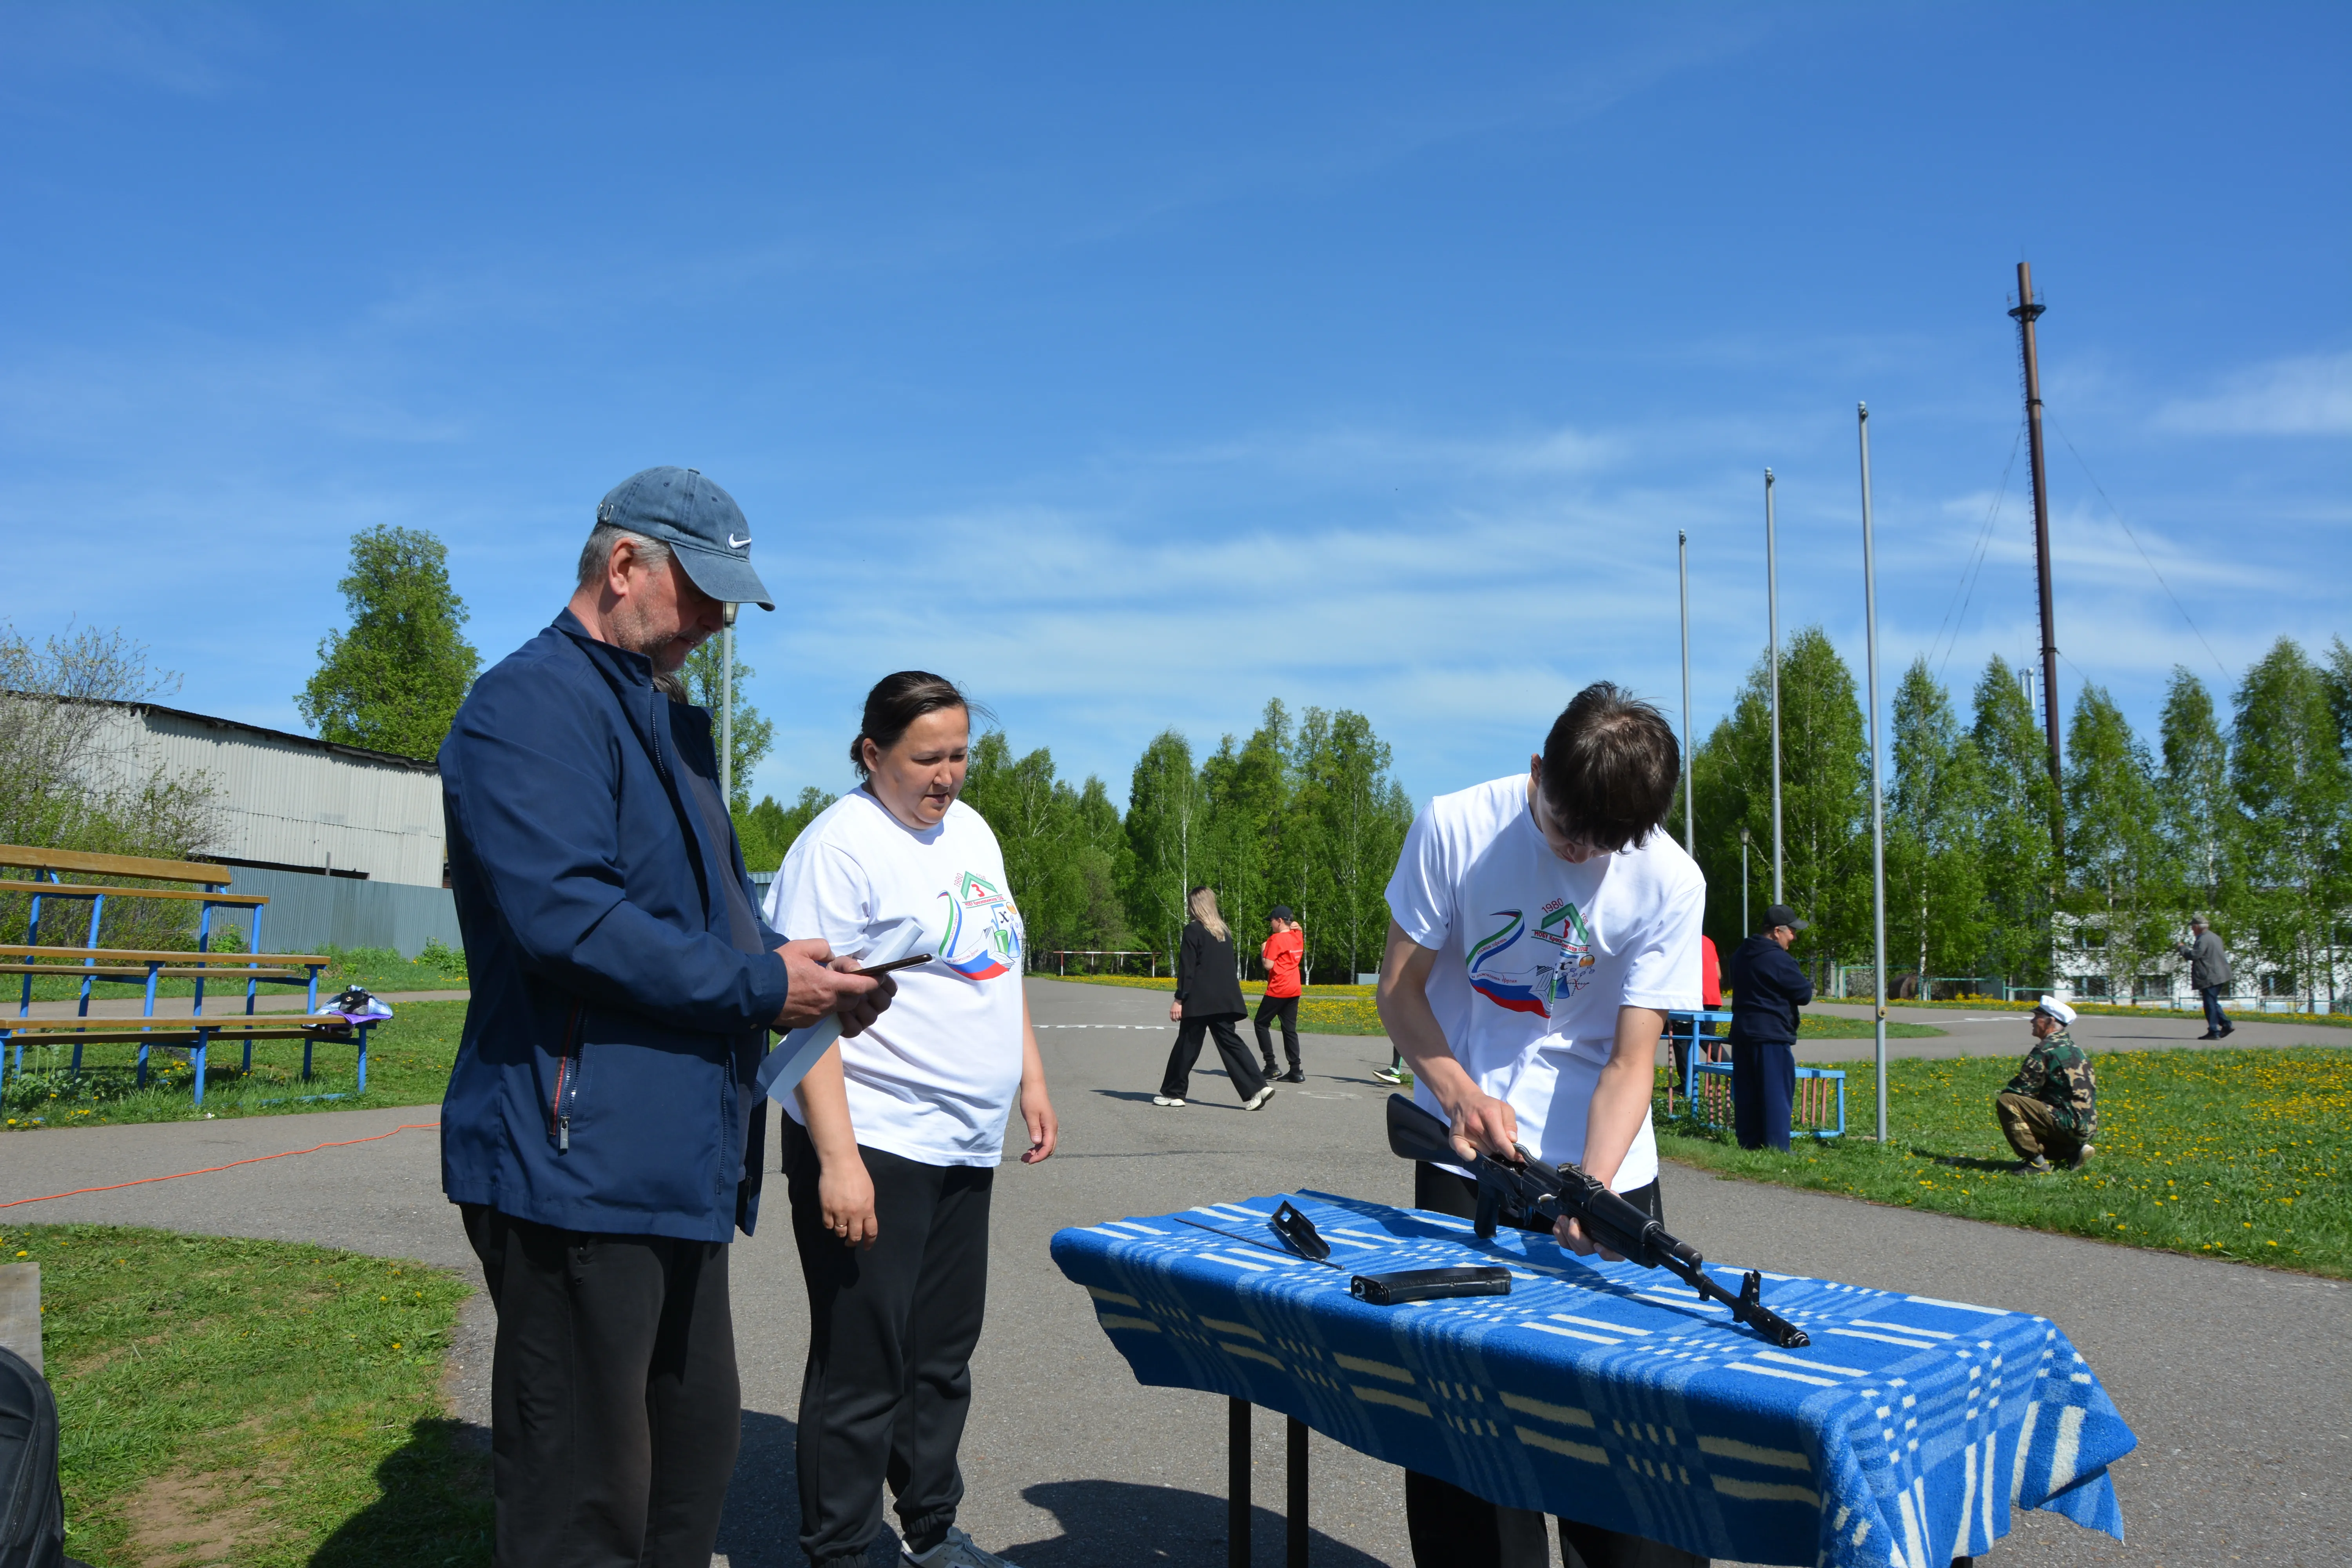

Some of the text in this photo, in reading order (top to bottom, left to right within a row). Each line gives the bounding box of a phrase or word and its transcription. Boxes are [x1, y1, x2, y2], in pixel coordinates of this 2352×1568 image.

[954, 873, 963, 887] 1980
[971, 884, 985, 897] 3
[1542, 898, 1564, 913] 1980
